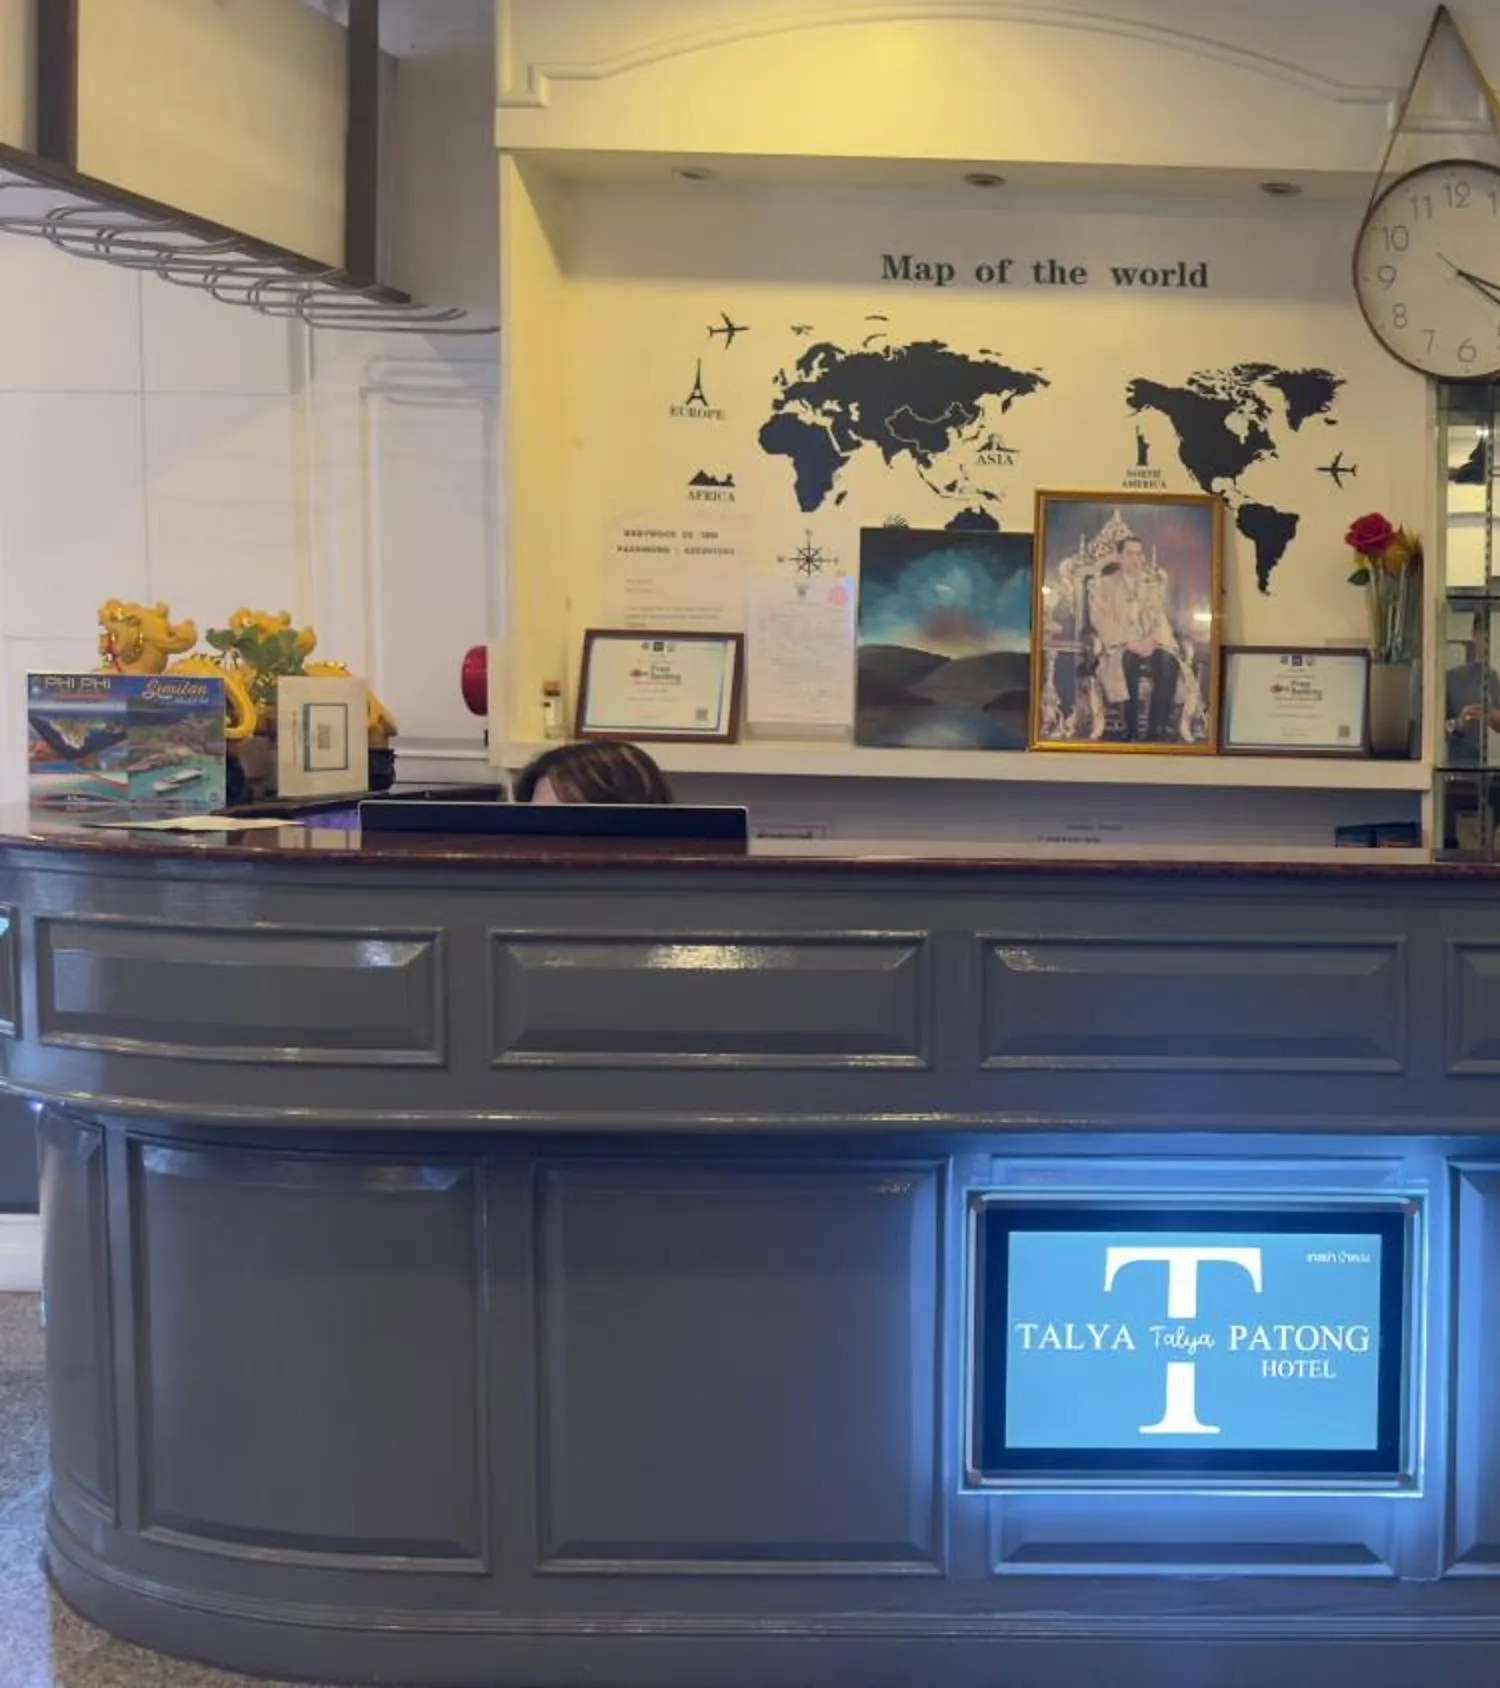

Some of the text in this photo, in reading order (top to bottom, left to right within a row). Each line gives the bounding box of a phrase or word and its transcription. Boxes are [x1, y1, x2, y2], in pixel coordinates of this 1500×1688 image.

[1410, 194, 1433, 222] 11
[1442, 181, 1472, 210] 12
[1488, 191, 1499, 216] 1
[1382, 225, 1410, 253] 10
[881, 253, 1209, 288] Map of the world
[1377, 266, 1397, 291] 9
[1393, 304, 1409, 329] 8
[1422, 328, 1438, 353] 7
[1457, 337, 1477, 363] 6
[669, 405, 726, 421] EUROPE
[975, 451, 1015, 466] ASIA
[687, 489, 736, 503] AFRICA
[1122, 479, 1167, 489] AMERICA
[45, 677, 111, 689] PHI PHI
[1015, 1323, 1370, 1355] TALYA Talya PATONG
[1103, 1246, 1263, 1434] T
[1261, 1359, 1336, 1379] HOTEL
